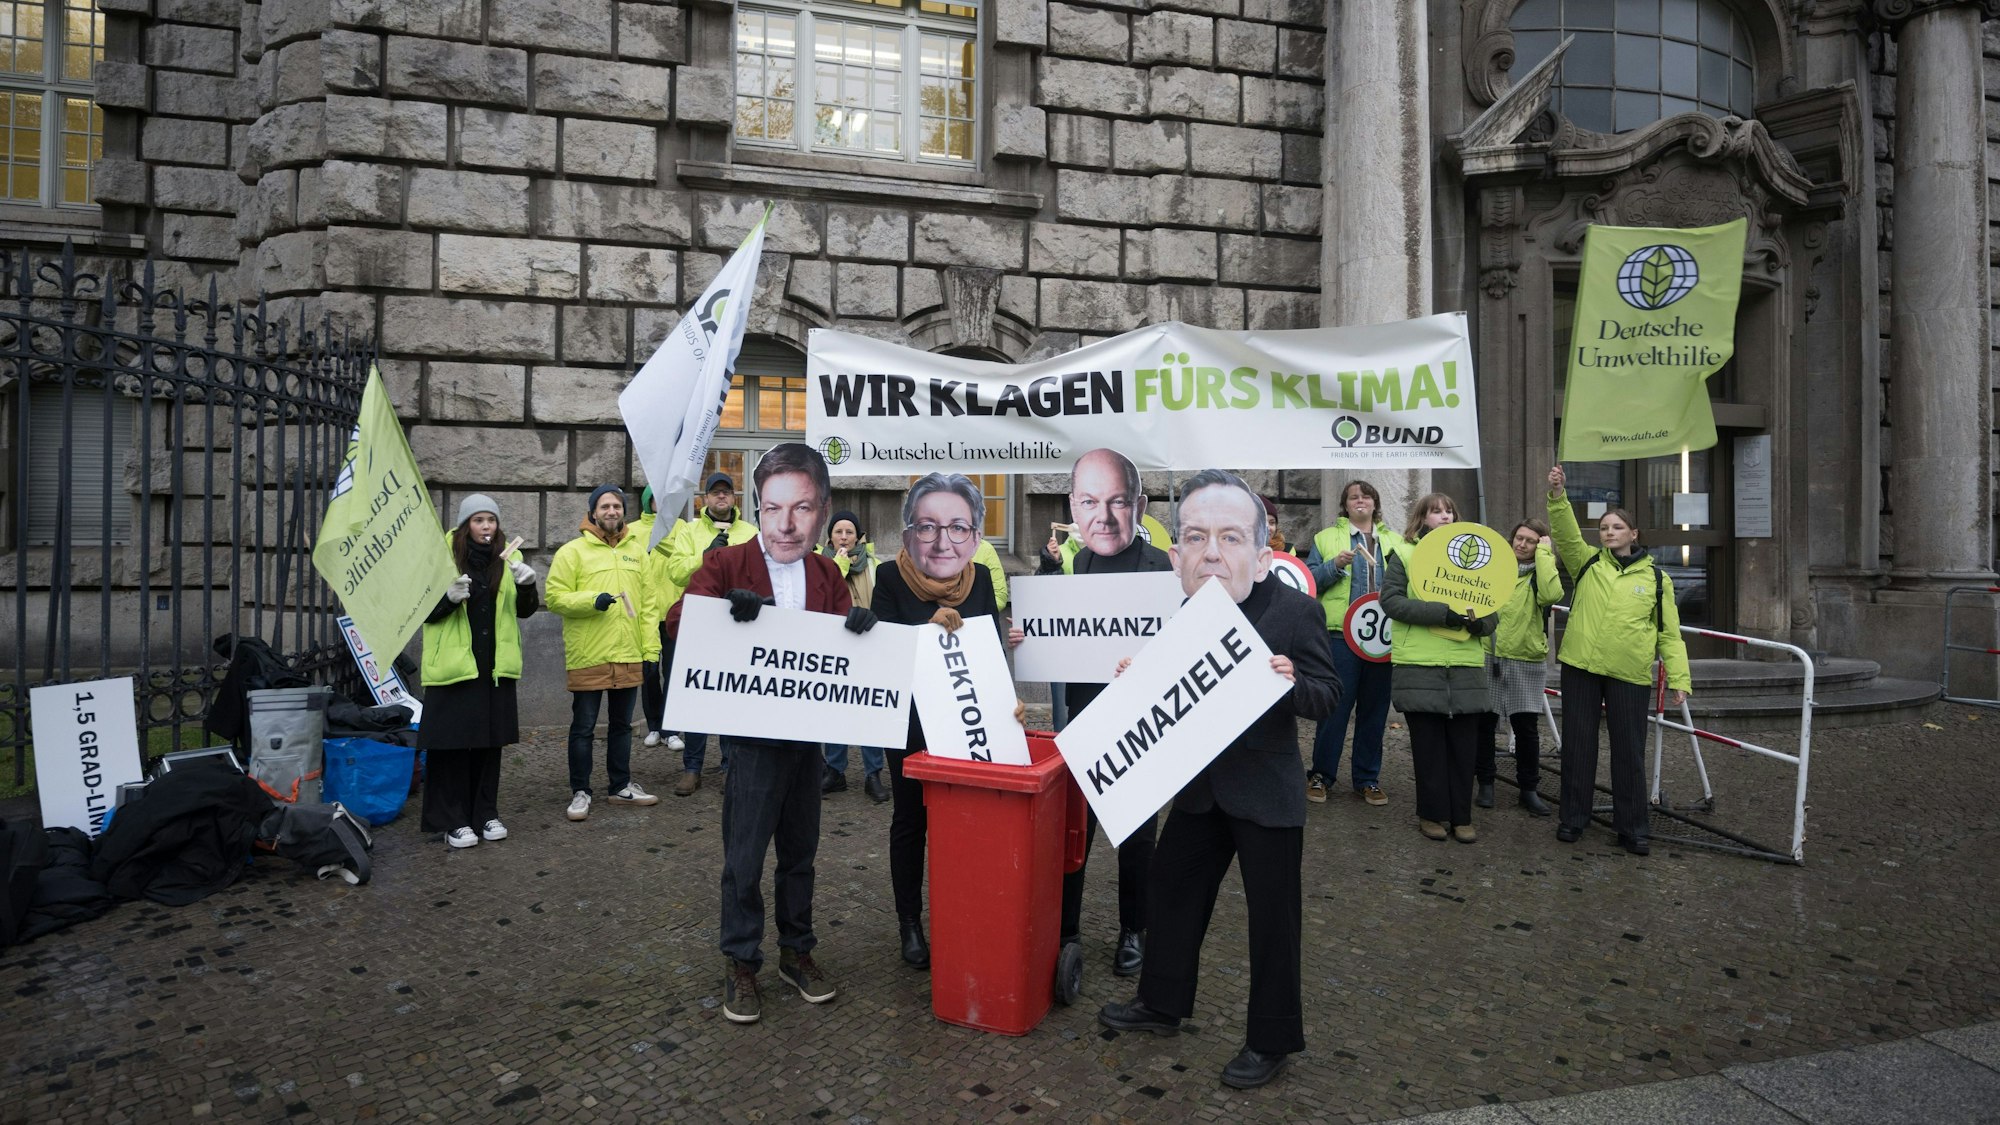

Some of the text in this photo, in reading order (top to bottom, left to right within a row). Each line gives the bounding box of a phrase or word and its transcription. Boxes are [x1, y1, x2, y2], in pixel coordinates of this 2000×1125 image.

[1598, 316, 1703, 340] Deutsche
[1577, 346, 1721, 367] Umwelthilfe
[818, 352, 1461, 418] WIR KLAGEN FÜRS KLIMA!
[1365, 425, 1444, 445] BUND
[1601, 428, 1669, 444] www.duh.de
[861, 441, 1062, 461] Deutsche Umwelthilfe
[1330, 451, 1359, 459] FRIENDS
[1435, 566, 1491, 590] Deutsche
[1422, 579, 1496, 608] Umwelthilfe
[750, 645, 850, 677] PARISER
[685, 667, 900, 709] KLIMAABKOMMEN
[72, 691, 97, 725] 1,5
[1086, 627, 1253, 796] KLIMAZIELE
